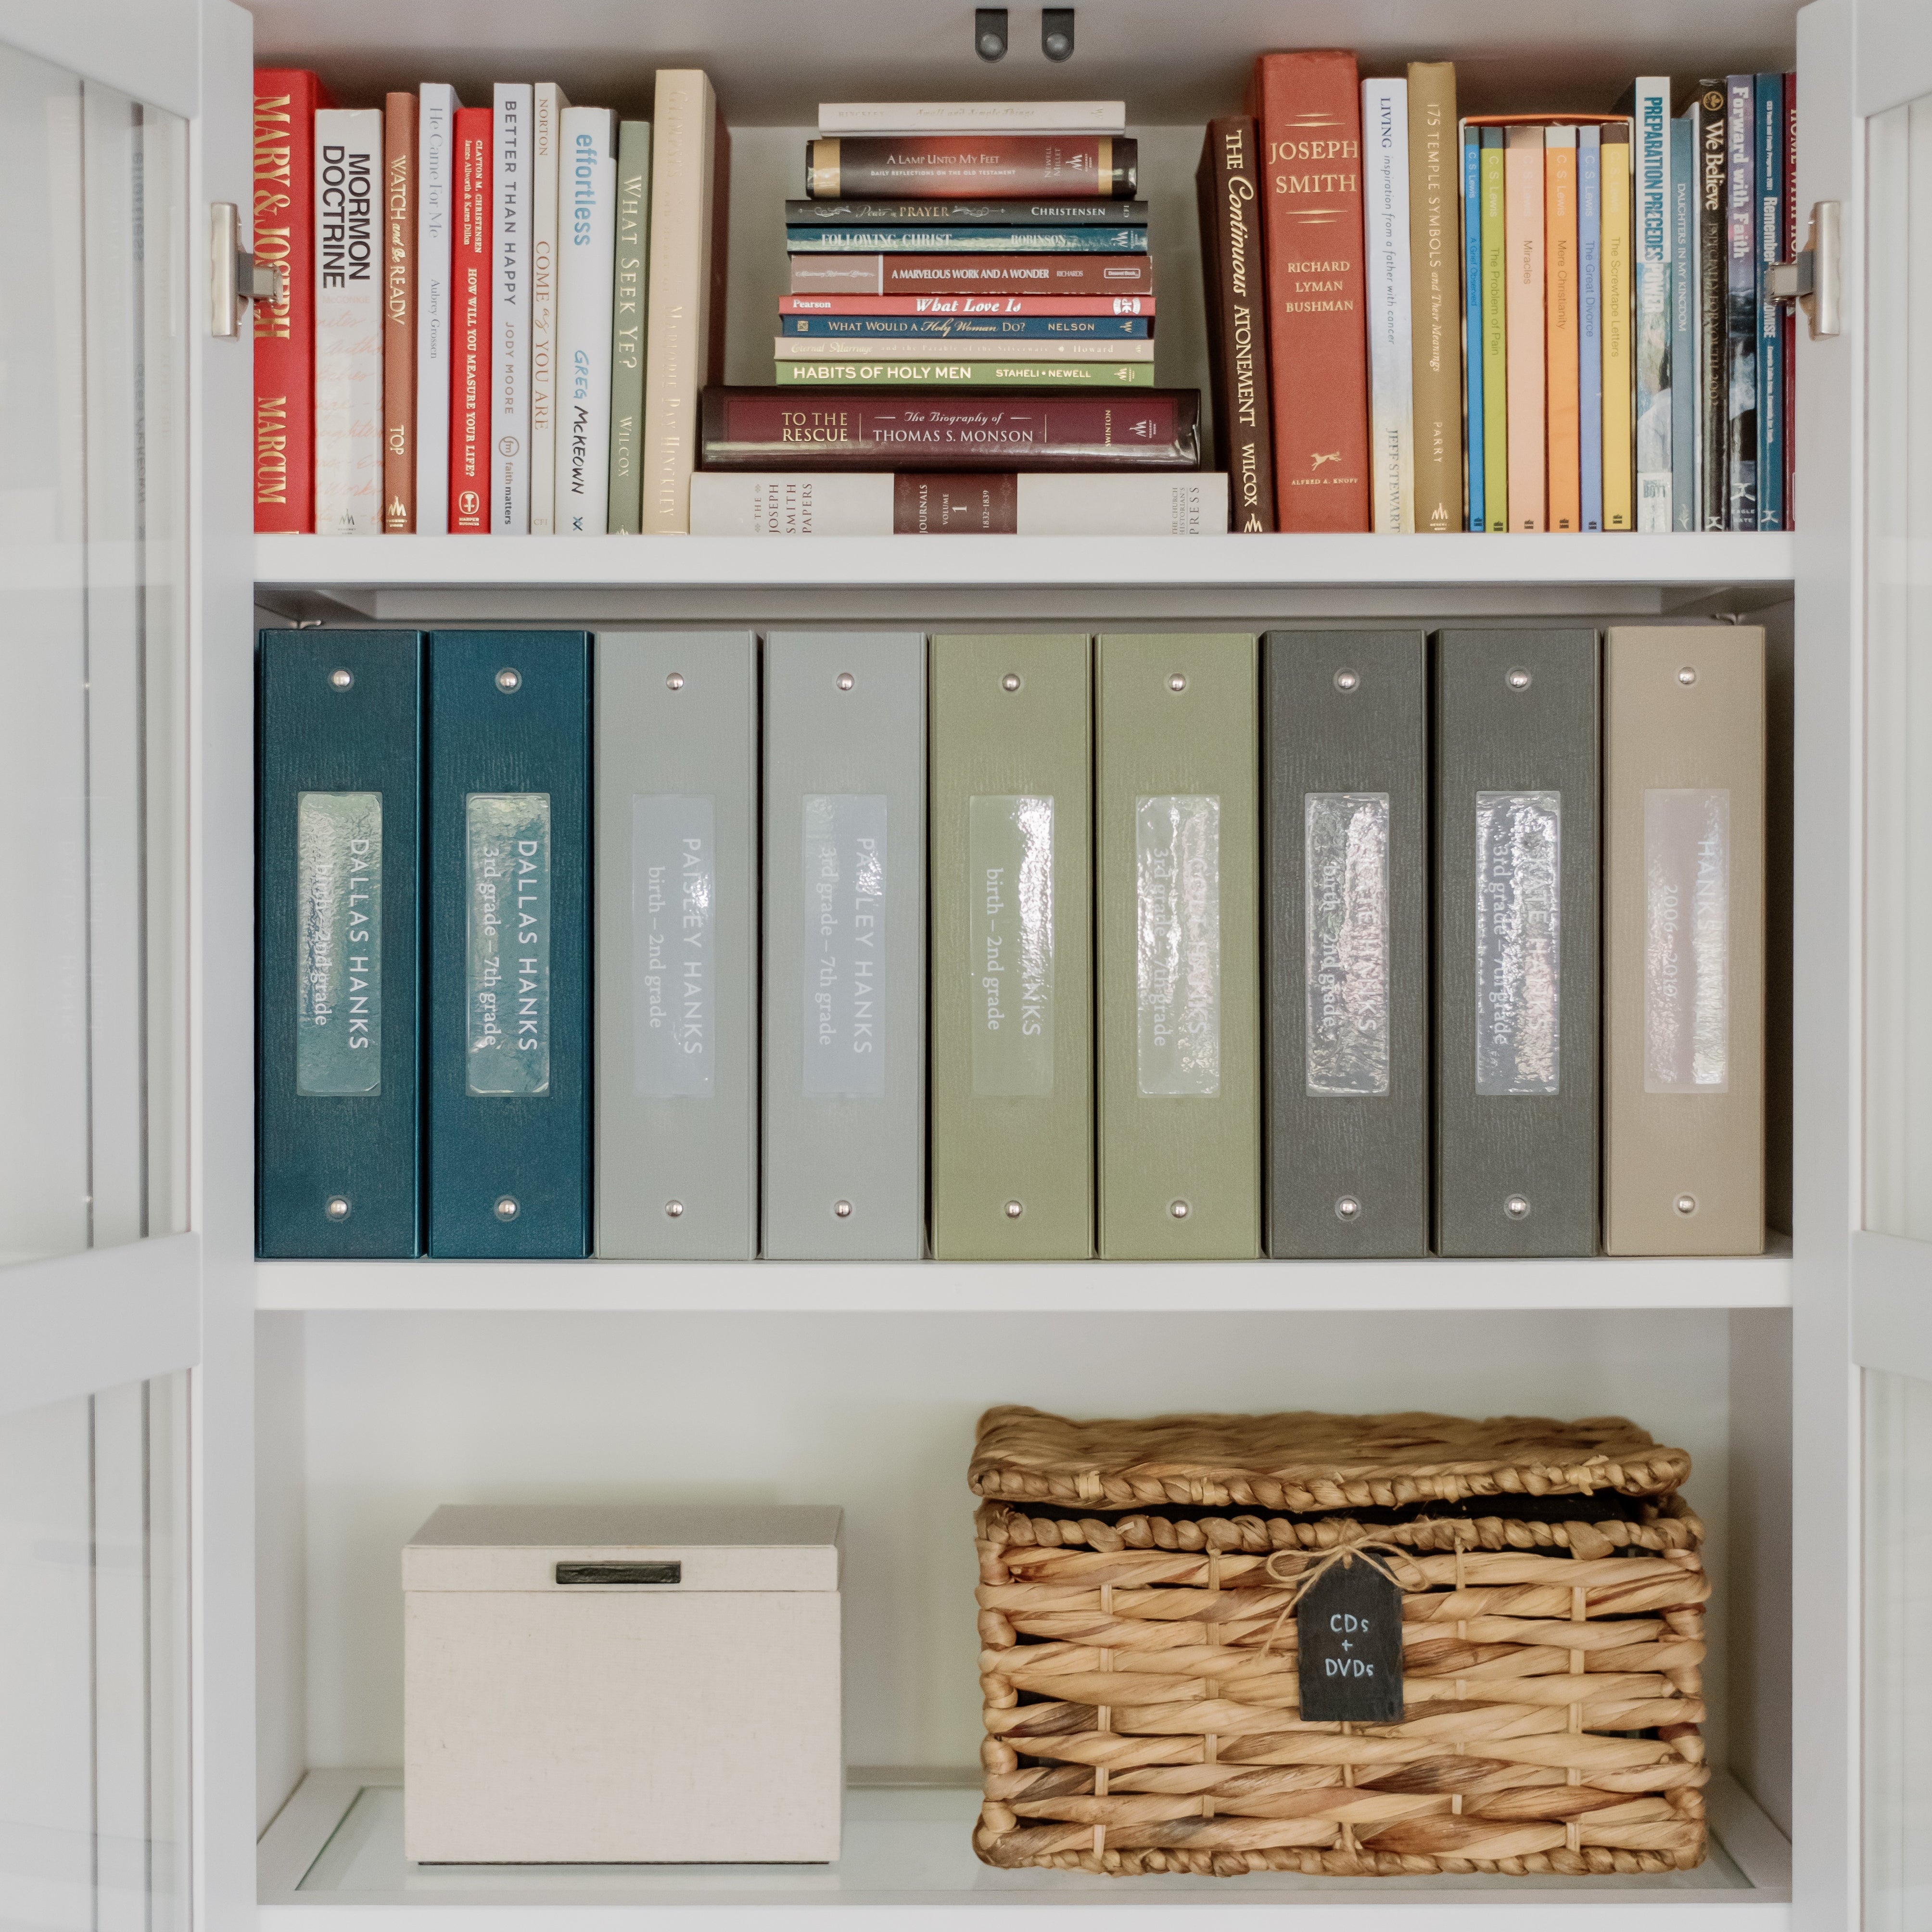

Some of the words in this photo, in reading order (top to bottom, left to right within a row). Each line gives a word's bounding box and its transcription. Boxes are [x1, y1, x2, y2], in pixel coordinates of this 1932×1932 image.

[430, 107, 443, 129] He
[539, 98, 548, 156] NORTON
[1380, 98, 1393, 148] LIVING
[1427, 104, 1441, 126] 175
[1706, 120, 1724, 150] We
[1732, 87, 1749, 164] Forward
[429, 134, 443, 180] Came
[505, 101, 517, 173] BETTER
[1226, 129, 1243, 170] THE
[1269, 140, 1359, 165] JOSEPH
[1644, 97, 1663, 189] PREPARATION
[887, 155, 896, 164] A
[899, 155, 925, 164] LAMP
[927, 154, 957, 164] UNTO
[959, 154, 977, 164] MY
[980, 154, 1000, 164] FEET
[1427, 132, 1440, 191] TEMPLE
[429, 184, 443, 207] For
[475, 181, 482, 191] M.
[574, 134, 597, 246] effortless
[1275, 174, 1357, 194] SMITH
[1380, 155, 1395, 210] inspiration
[1706, 153, 1725, 211] Believe
[1732, 169, 1749, 208] with
[323, 145, 345, 289] DOCTRINE
[348, 154, 370, 280] MORMON
[429, 212, 442, 238] Me
[505, 182, 516, 233] THAN
[622, 175, 642, 244] WHAT
[1031, 207, 1106, 216] CHRISTENSEN
[1382, 213, 1396, 238] from
[1644, 193, 1664, 261] PRECEDES
[1677, 183, 1686, 244] DAUGHTERS
[821, 234, 896, 247] FOLLOWING
[902, 234, 953, 246] CHRIST
[1228, 176, 1254, 297] Continuous
[1428, 196, 1442, 267] SYMBOLS
[1585, 241, 1595, 260] The
[1611, 237, 1621, 256] The
[1732, 213, 1750, 258] Faith
[536, 241, 550, 302] COME
[1287, 261, 1350, 273] RICHARD
[1383, 250, 1397, 282] father
[1524, 241, 1533, 284] Miracles
[1557, 241, 1567, 267] Mere
[1678, 248, 1686, 258] IN
[1678, 262, 1686, 278] MY
[468, 268, 477, 295] HOW
[505, 242, 516, 305] HAPPY
[620, 257, 639, 314] SEEK
[891, 270, 898, 279] A
[899, 270, 951, 279] MARVELOUS
[952, 269, 979, 279] WORK
[980, 269, 1001, 279] AND
[1002, 269, 1009, 279] A
[1010, 269, 1049, 279] WONDER
[1296, 280, 1343, 293] LYMAN
[1431, 272, 1441, 292] and
[1586, 264, 1596, 292] Great
[1610, 260, 1621, 317] Screwtape
[1644, 264, 1665, 313] POWER
[427, 279, 440, 315] Aubrey
[467, 298, 476, 327] WILL
[793, 299, 831, 308] Pearson
[915, 298, 959, 312] What
[963, 298, 1000, 312] Love
[1004, 298, 1022, 312] Is
[1285, 301, 1353, 313] BUSHMAN
[1386, 286, 1397, 306] with
[1431, 293, 1442, 320] Their
[1556, 270, 1567, 330] Christianity
[1678, 281, 1687, 331] KINGDOM
[534, 307, 550, 335] as
[1048, 323, 1094, 331] NELSON
[1586, 297, 1595, 337] Divorce
[430, 318, 440, 358] Grossen
[467, 329, 476, 351] YOU
[506, 321, 514, 358] JODY
[619, 326, 638, 368] YE?
[1073, 345, 1114, 353] Howard
[1429, 323, 1442, 372] Meanings
[1611, 321, 1621, 357] Letters
[535, 339, 549, 382] YOU
[794, 367, 856, 379] HABITS
[860, 367, 883, 379] OF
[887, 367, 931, 379] HOLY
[935, 367, 971, 379] MEN
[1234, 305, 1256, 427] ATONEMENT
[466, 354, 476, 409] MEASURE
[505, 364, 514, 414] MOORE
[466, 412, 475, 442] YOUR
[535, 390, 549, 431] ARE
[782, 413, 806, 426] TO
[812, 413, 848, 426] THE
[904, 411, 925, 422] The
[928, 411, 989, 425] Biography
[991, 412, 1005, 425] of
[257, 396, 286, 505] MARCUM
[390, 424, 404, 455] TOP
[618, 416, 633, 478] WILCOX
[783, 428, 848, 442] RESCUE
[873, 430, 941, 442] THOMAS
[946, 430, 957, 442] S.
[961, 431, 1033, 442] MONSON
[1386, 428, 1399, 462] JEFF
[1433, 421, 1443, 463] PARRY
[466, 445, 475, 477] LIFE?
[505, 462, 514, 484] faith
[1242, 443, 1258, 507] WILCOX
[505, 486, 513, 524] matters
[769, 483, 781, 534] JOSEPH
[786, 483, 797, 534] SMITH
[802, 483, 813, 534] PAPERS
[919, 484, 928, 534] JOURNALS
[1189, 487, 1199, 535] PRESS
[1388, 464, 1400, 533] STEWART
[483, 847, 502, 879] 3rd
[349, 839, 369, 942] DALLAS
[478, 882, 502, 937] grade
[517, 840, 538, 945] DALLAS
[648, 866, 666, 914] birth
[816, 882, 839, 937] grade
[986, 868, 1004, 916] birth
[648, 934, 666, 971] 2nd
[819, 956, 838, 989] 7th
[986, 936, 1004, 972] 2nd
[483, 957, 502, 989] 7th
[349, 956, 369, 1049] HANKS
[479, 991, 502, 1047] grade
[518, 957, 538, 1051] HANKS
[645, 975, 667, 1029] grade
[814, 991, 838, 1046] grade
[982, 975, 1005, 1031] grade
[1330, 1614, 1369, 1633] CDs
[1325, 1658, 1374, 1678] DVDs
